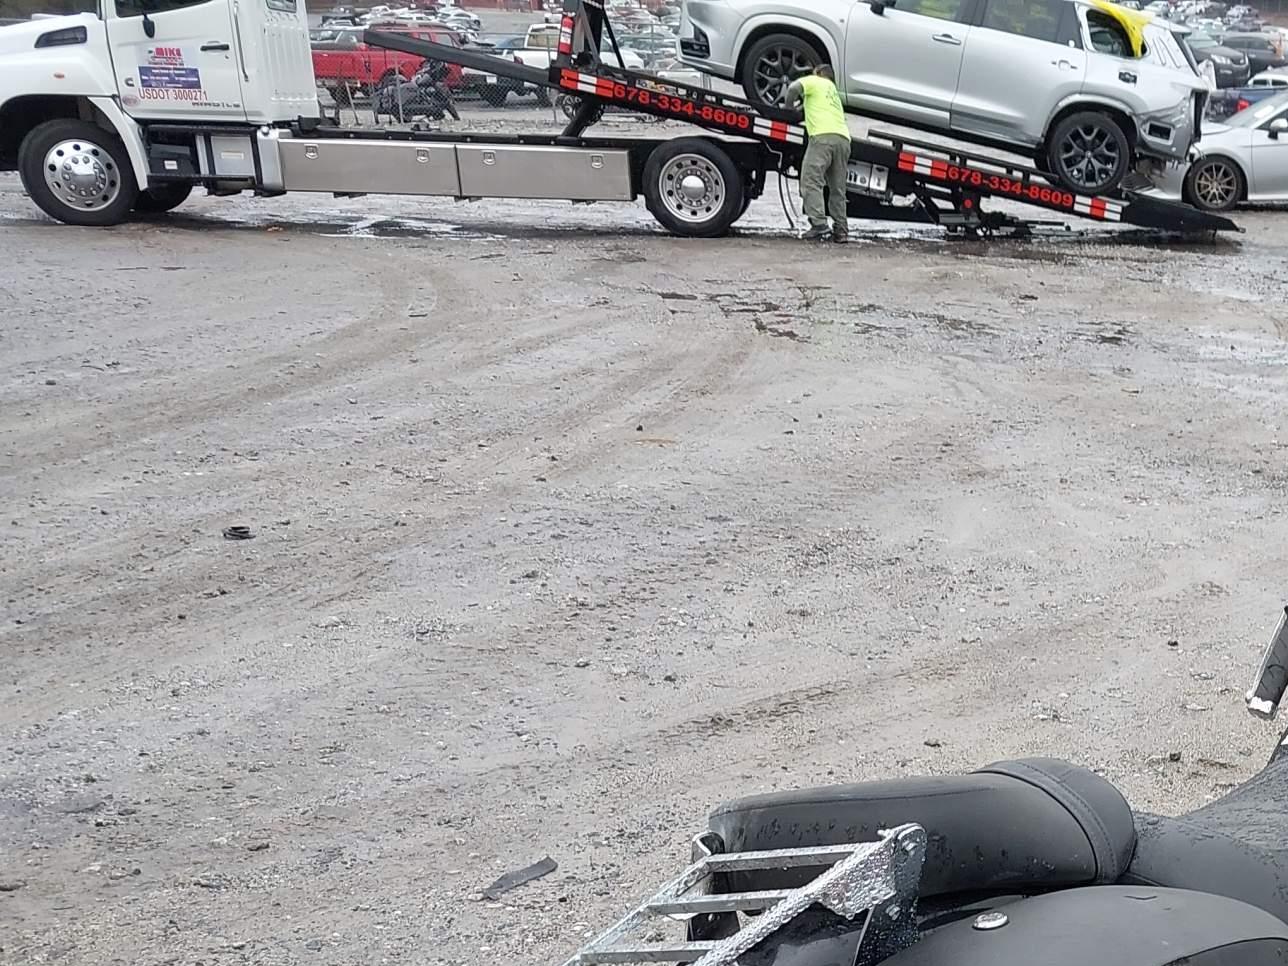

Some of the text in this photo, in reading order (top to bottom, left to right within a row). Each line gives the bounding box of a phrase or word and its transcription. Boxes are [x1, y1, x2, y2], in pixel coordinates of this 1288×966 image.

[139, 88, 208, 101] USDOT 3000271
[614, 82, 750, 129] 678-334-8609
[947, 166, 1074, 207] 678-334-8609
